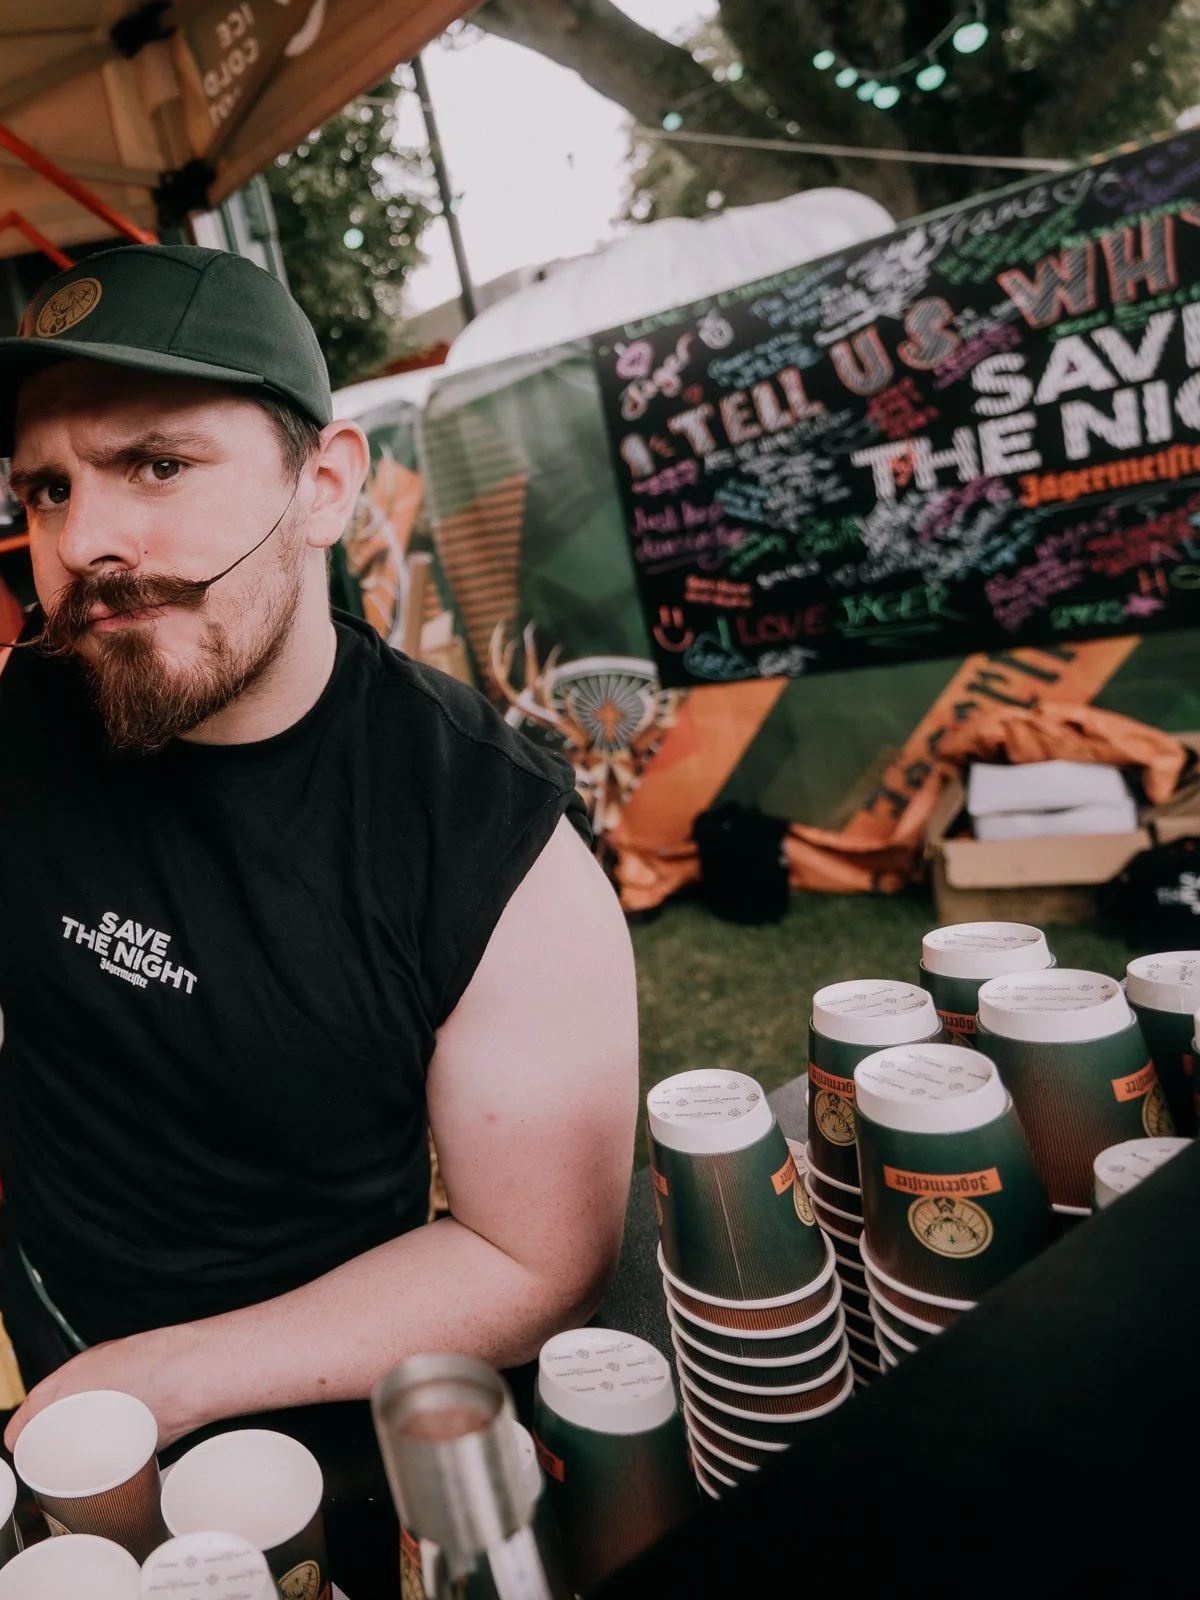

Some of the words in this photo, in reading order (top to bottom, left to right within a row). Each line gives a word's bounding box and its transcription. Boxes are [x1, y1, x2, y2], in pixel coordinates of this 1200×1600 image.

[667, 367, 826, 456] TELL
[830, 296, 964, 395] US
[997, 204, 1200, 329] WH
[850, 411, 1043, 500] THE
[61, 915, 112, 957] THE
[113, 940, 198, 994] NIGHT
[98, 911, 172, 957] SAVE
